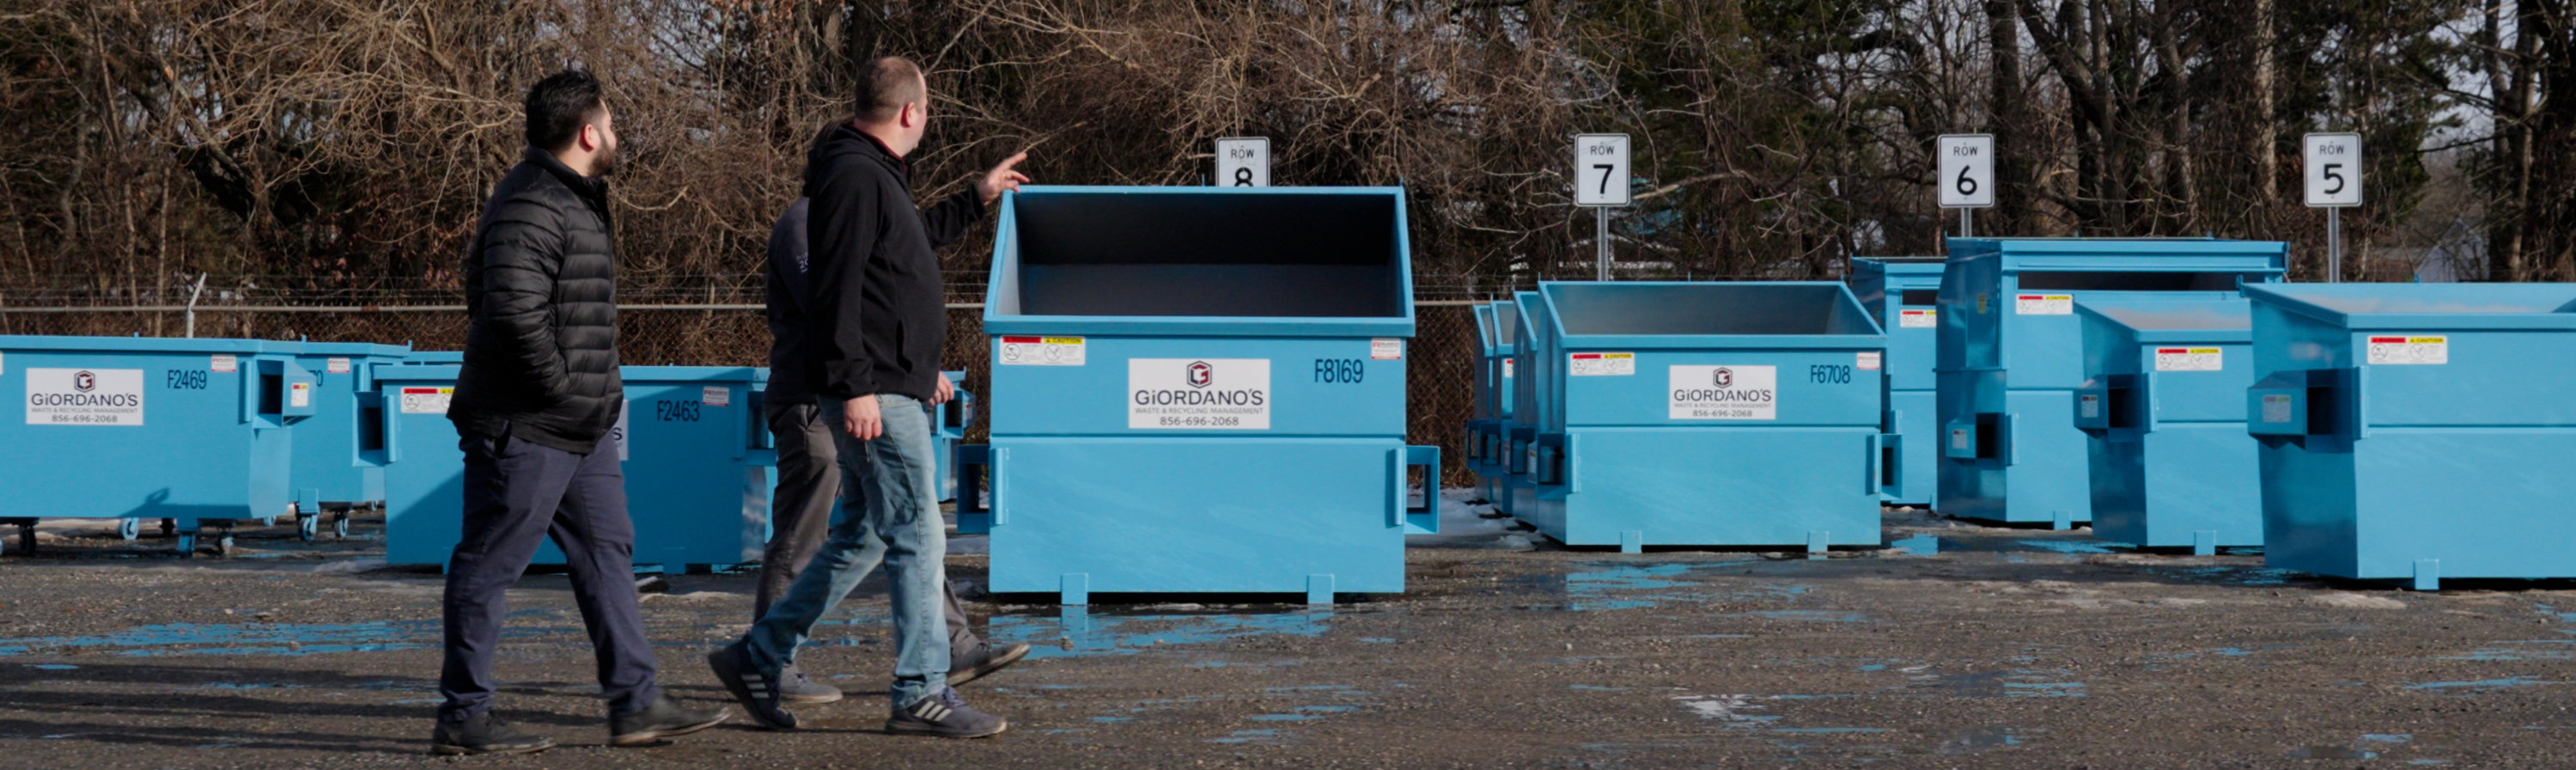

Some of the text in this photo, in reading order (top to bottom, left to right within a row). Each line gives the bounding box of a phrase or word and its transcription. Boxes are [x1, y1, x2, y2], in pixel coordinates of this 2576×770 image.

[1231, 149, 1254, 159] ROW
[1590, 145, 1614, 156] ROW
[1953, 146, 1978, 156] ROW
[2319, 144, 2344, 155] ROW
[1234, 167, 1253, 186] 8
[1593, 164, 1614, 194] 7
[1957, 164, 1977, 196] 6
[2323, 163, 2344, 195] 5
[167, 370, 207, 389] F2469
[1315, 358, 1364, 383] F8169
[1811, 364, 1850, 383] F6708
[657, 400, 700, 421] F2463
[1160, 416, 1239, 426] 856-696-2068
